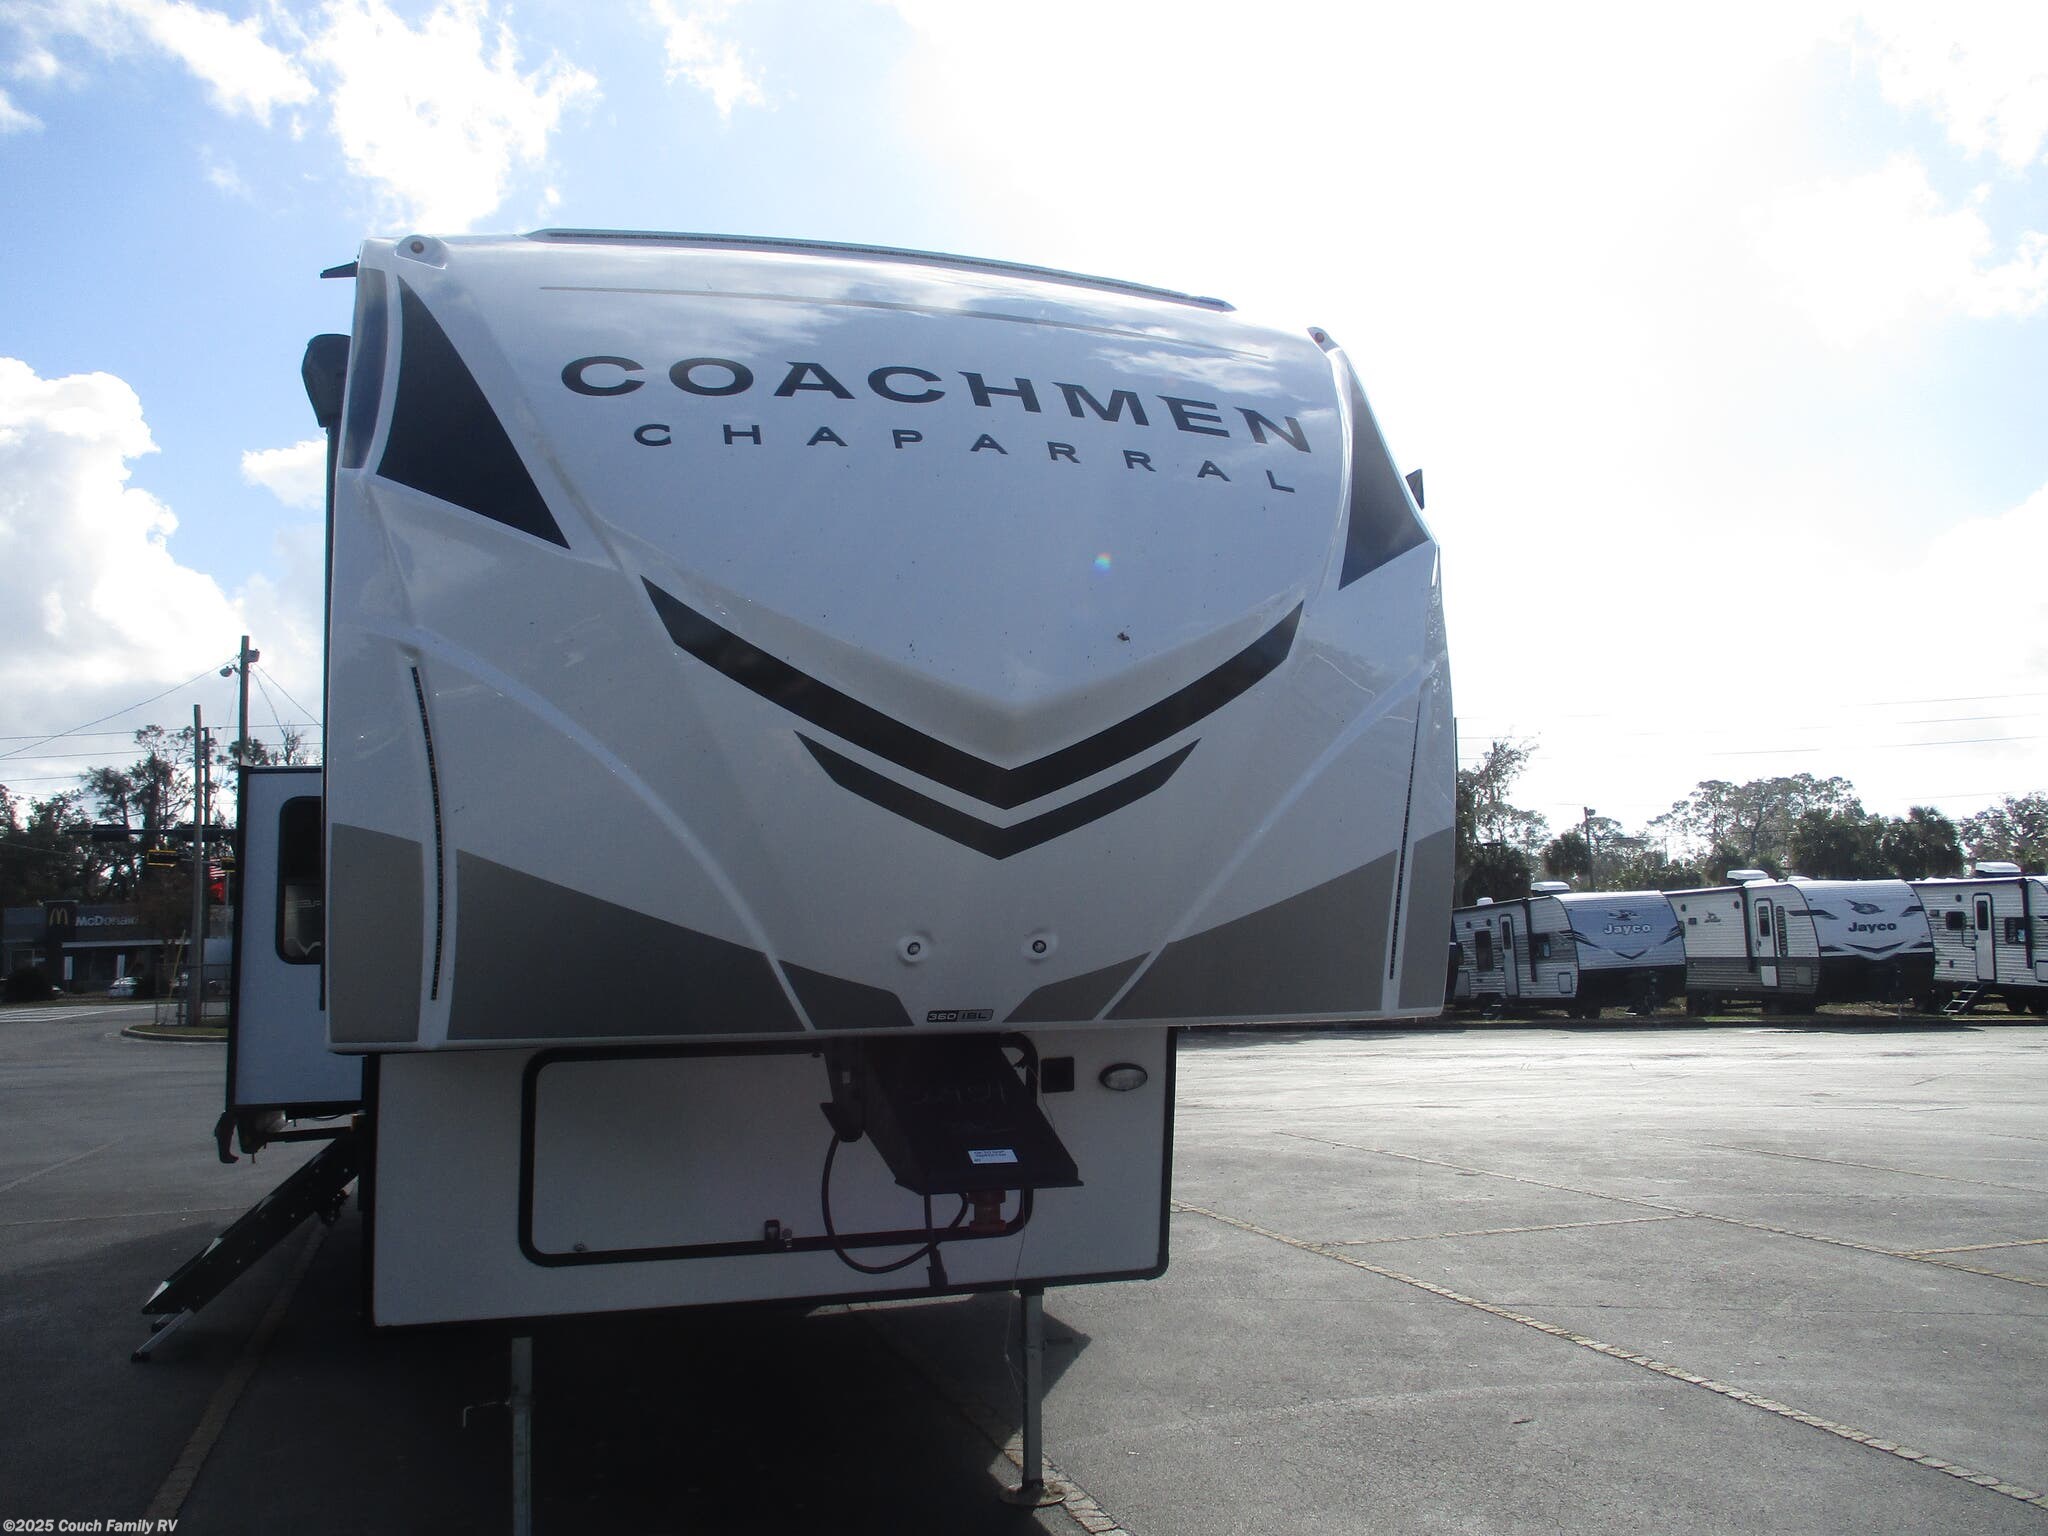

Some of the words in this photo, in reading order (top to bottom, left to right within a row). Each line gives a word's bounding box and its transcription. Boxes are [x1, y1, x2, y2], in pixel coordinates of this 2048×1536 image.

[560, 355, 1312, 454] COACHMEN
[633, 424, 1296, 493] CHAPARRAL
[1604, 924, 1651, 935] Jayco
[1848, 921, 1897, 934] Jayco
